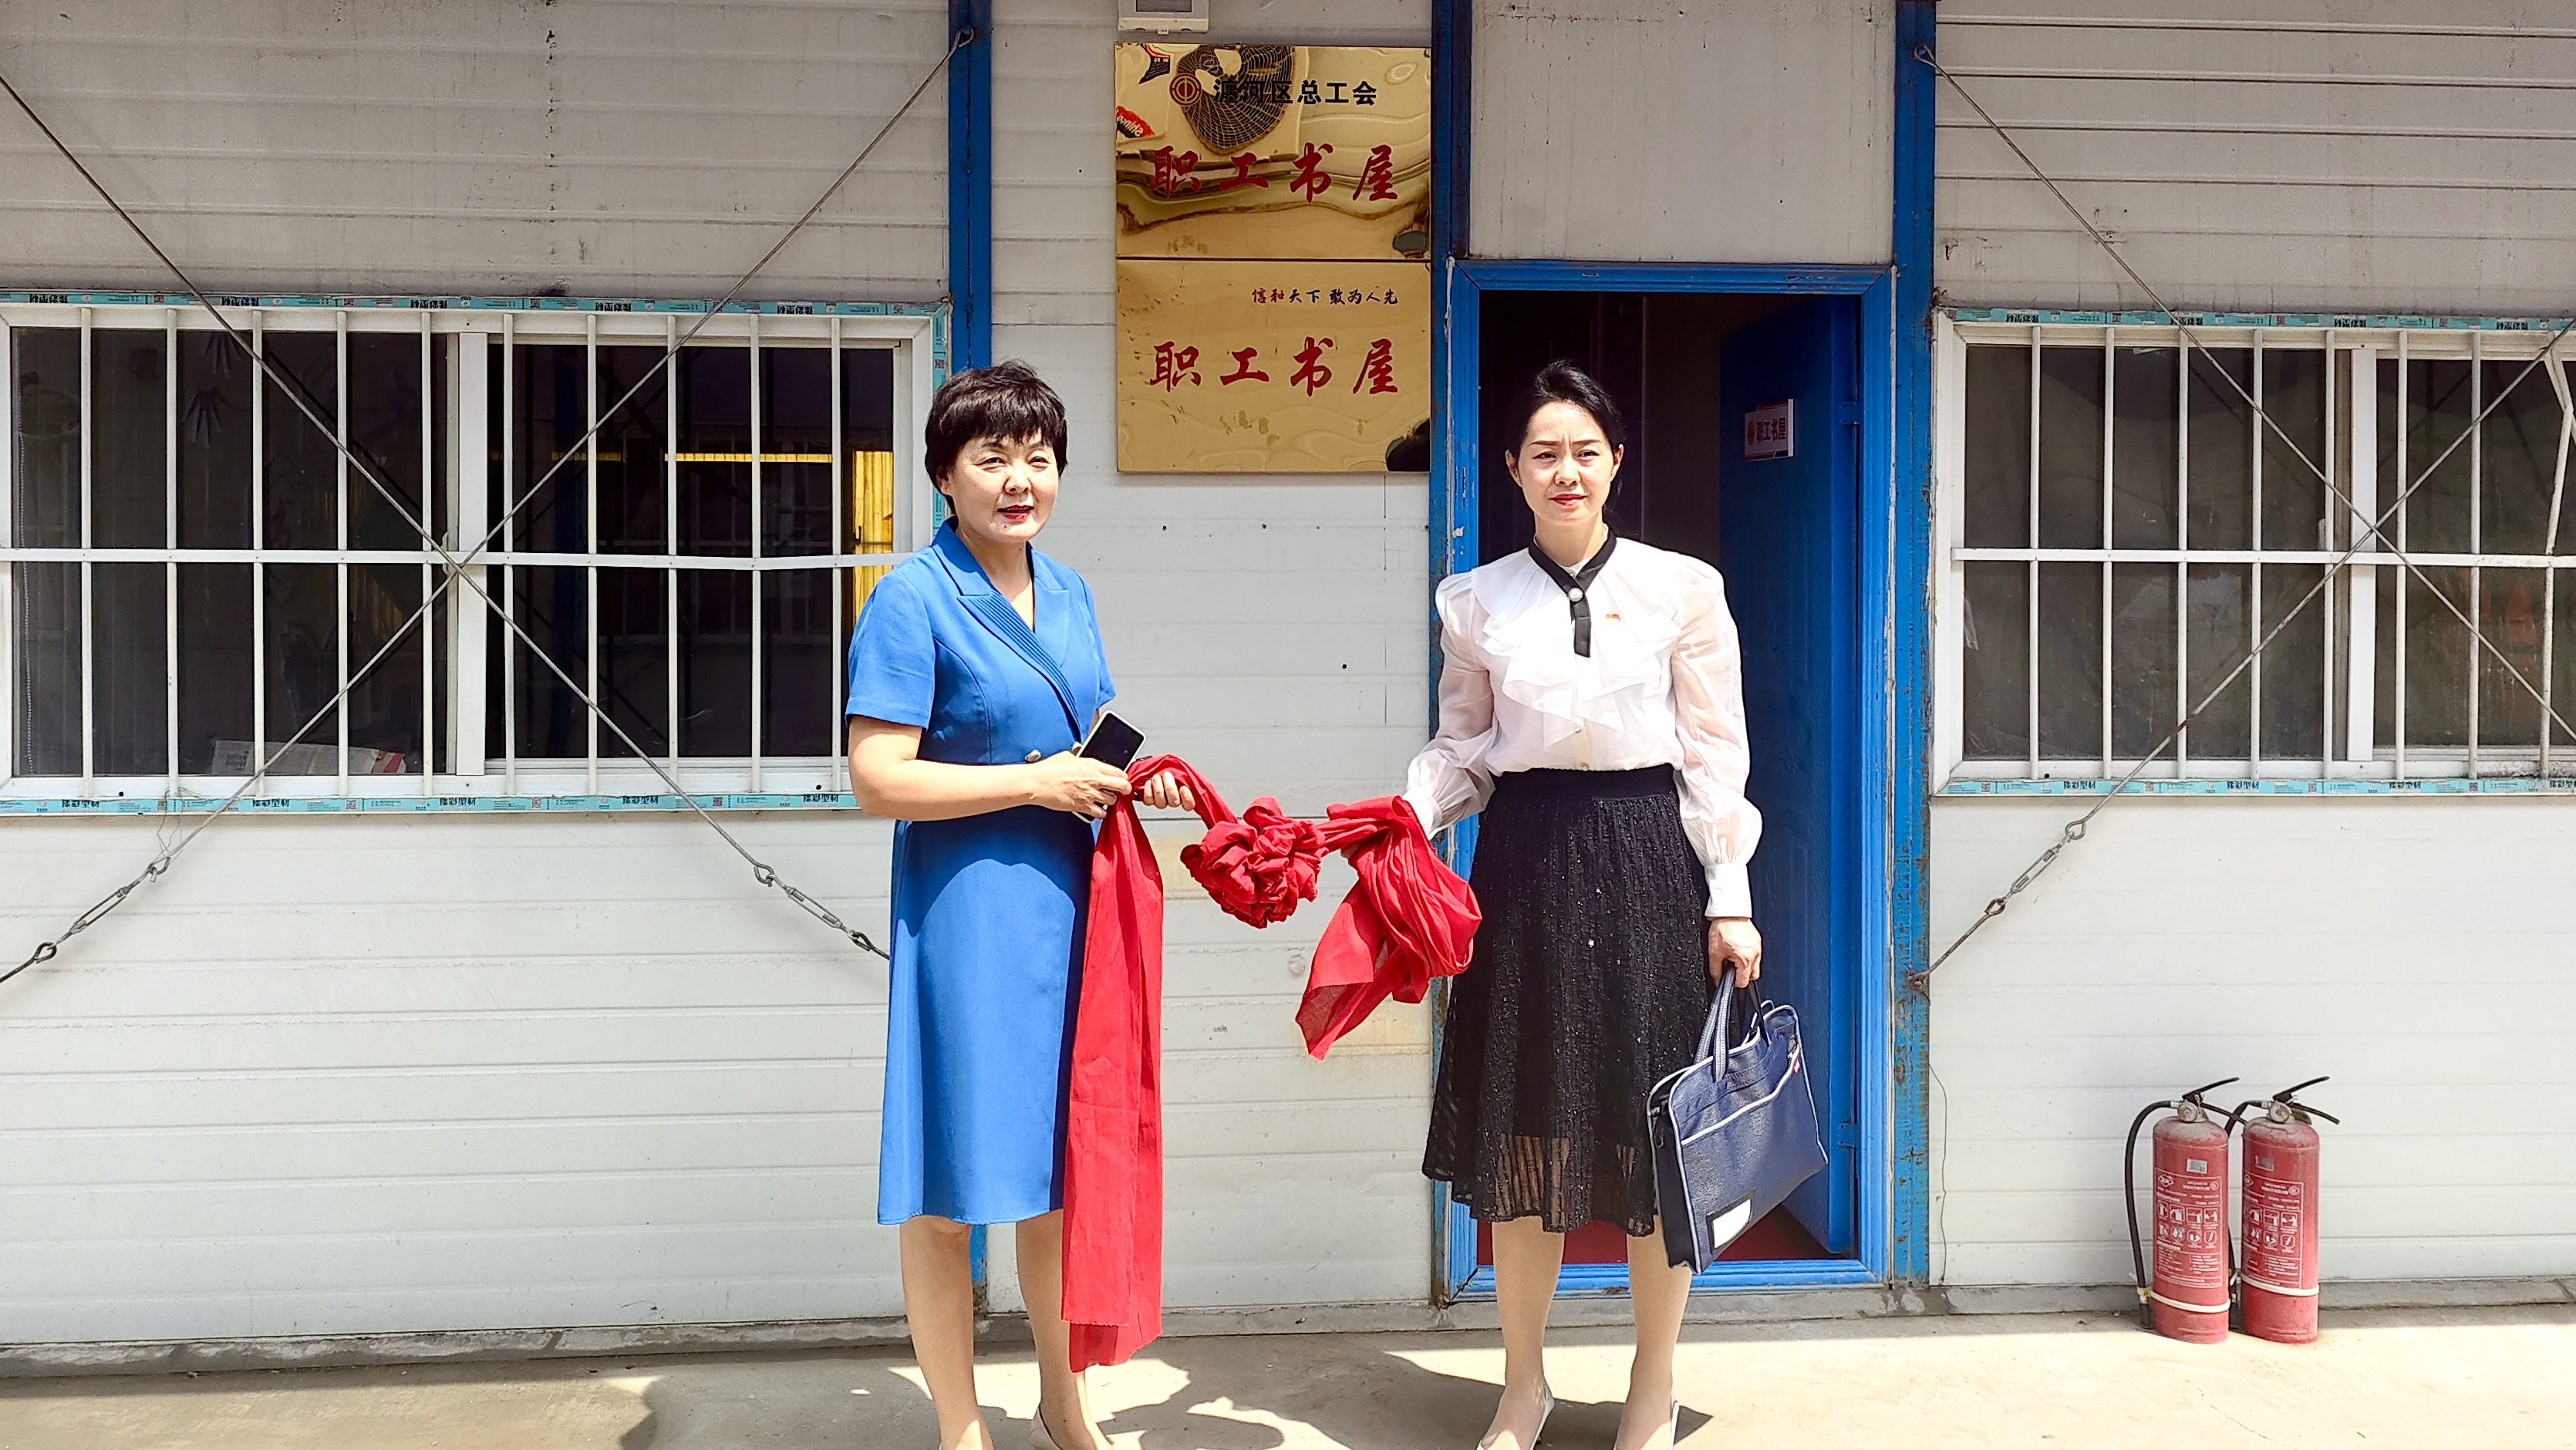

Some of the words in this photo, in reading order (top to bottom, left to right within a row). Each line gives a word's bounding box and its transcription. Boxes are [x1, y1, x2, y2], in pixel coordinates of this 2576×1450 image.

[1213, 79, 1377, 106] 瀍河区总工会
[1149, 143, 1398, 203] 职工书屋
[1252, 288, 1320, 304] 信和天下
[1329, 288, 1398, 305] 敢为人先
[1149, 336, 1398, 396] 职工书屋
